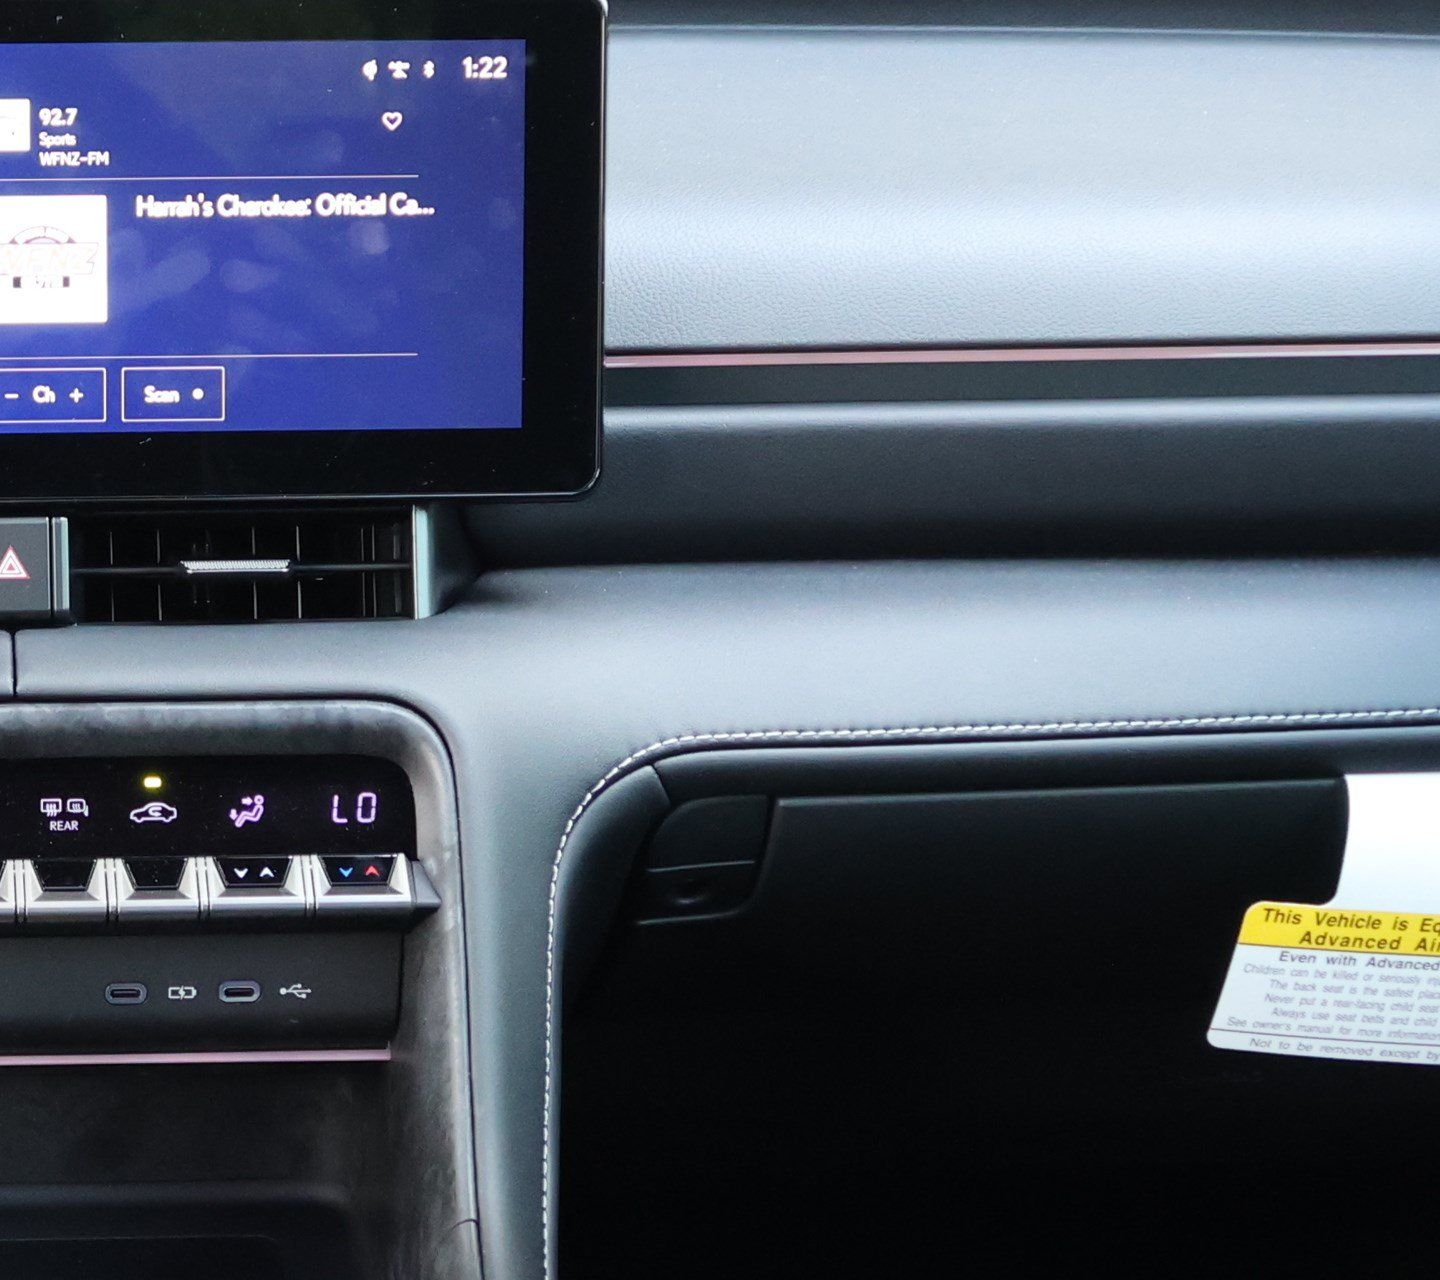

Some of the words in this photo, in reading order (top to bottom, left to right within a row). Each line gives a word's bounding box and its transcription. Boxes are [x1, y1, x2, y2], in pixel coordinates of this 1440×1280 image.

[462, 56, 508, 80] 1:22
[39, 108, 78, 125] 92.7
[39, 132, 76, 148] Sports
[39, 152, 110, 167] WFNZ-FM
[135, 193, 215, 218] Harrah's
[217, 194, 312, 217] Cherokee:
[315, 193, 387, 216] Official
[32, 385, 56, 404] Ch
[144, 385, 180, 404] Scan
[49, 820, 79, 831] REAR
[1263, 907, 1302, 925] This
[1315, 912, 1382, 930] Vehicle
[1392, 916, 1409, 931] is
[1299, 931, 1402, 950] Advanced
[1278, 950, 1317, 964] Even
[1326, 954, 1357, 967] with
[1365, 956, 1440, 971] Advanced
